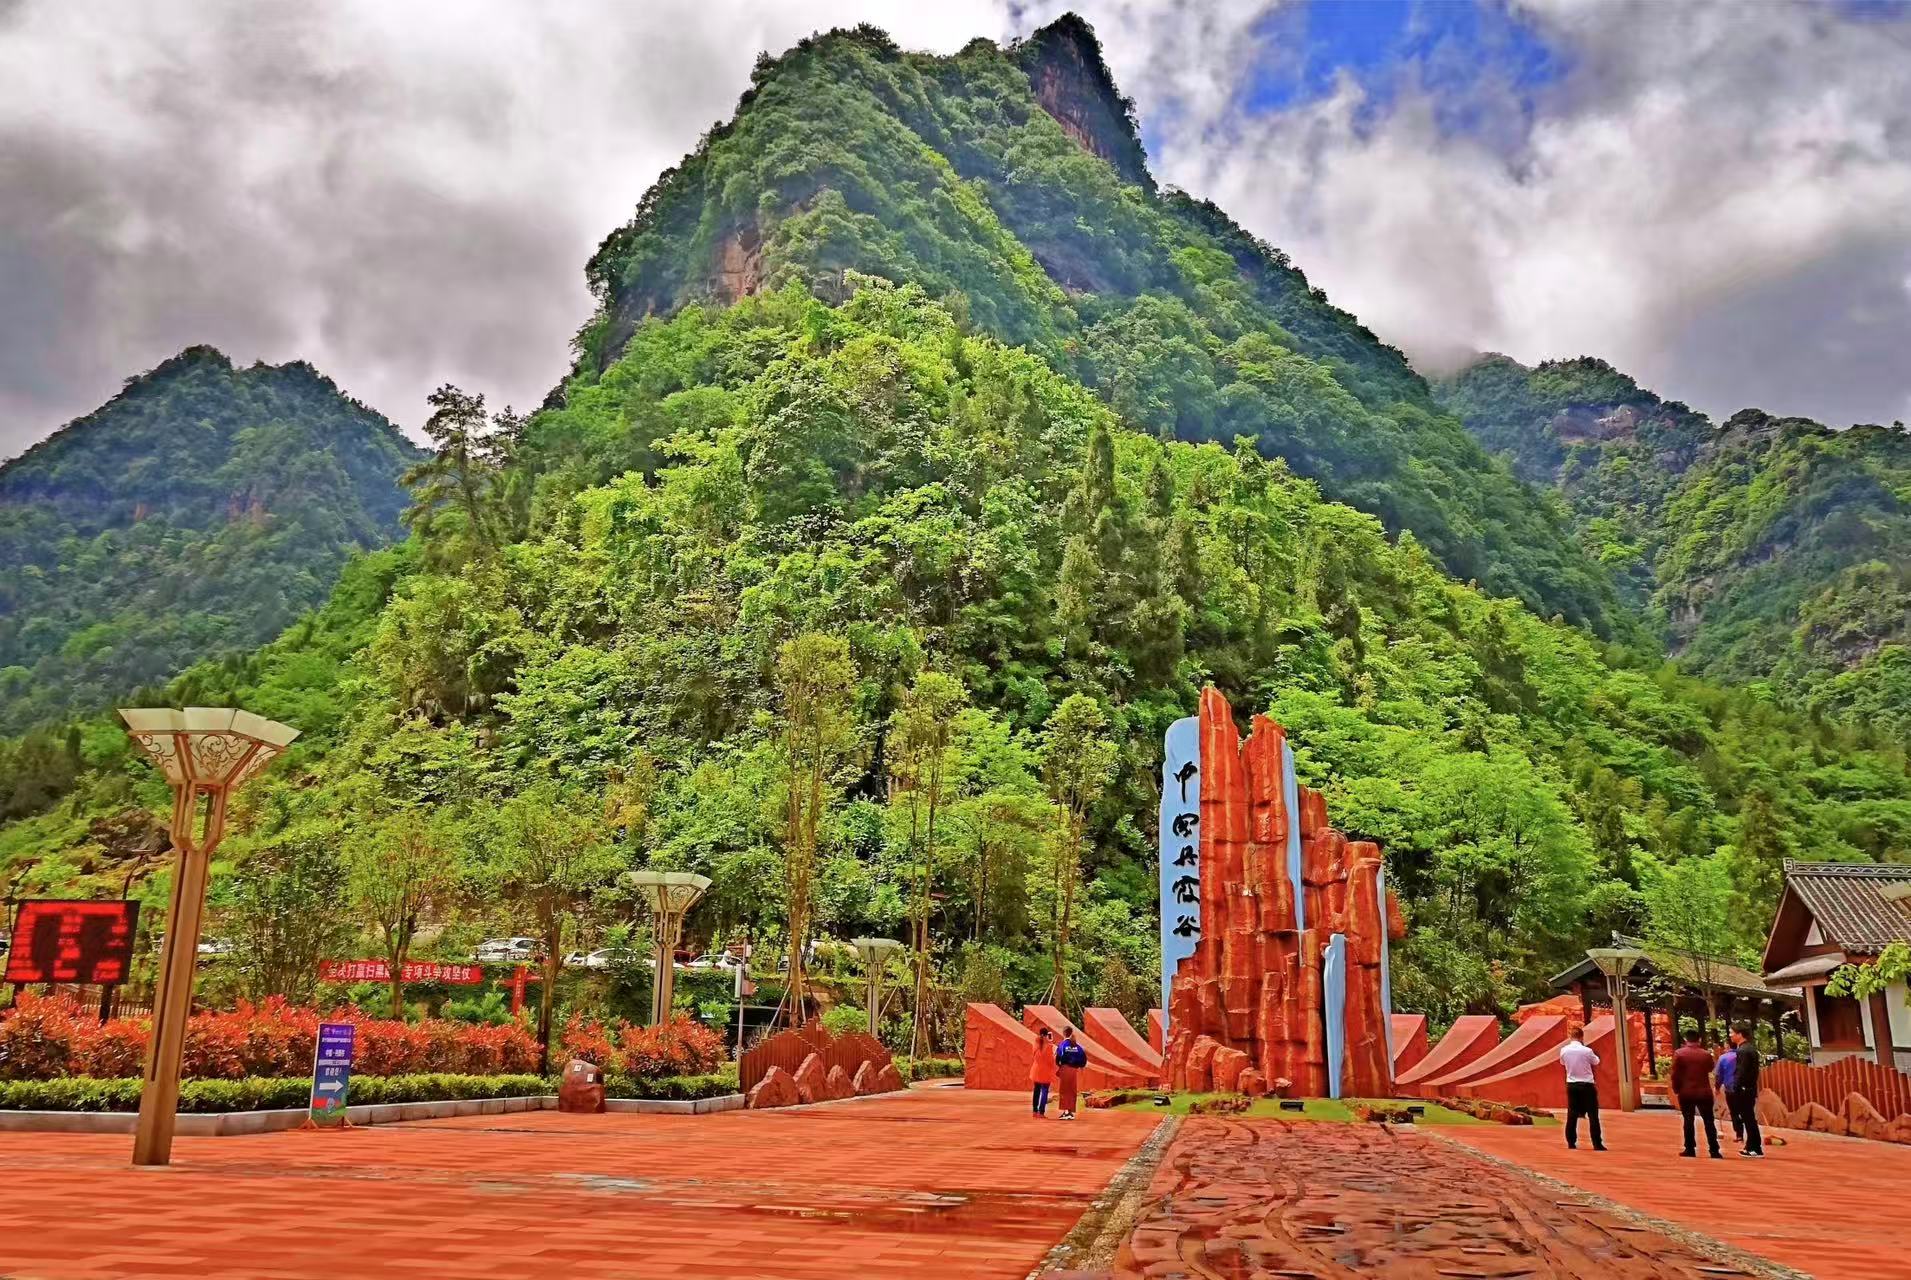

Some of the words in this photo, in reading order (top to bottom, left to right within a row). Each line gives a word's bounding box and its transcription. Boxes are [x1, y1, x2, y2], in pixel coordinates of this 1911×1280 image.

[328, 963, 472, 981] 坚决打赢扫黑专项斗争攻坚仗
